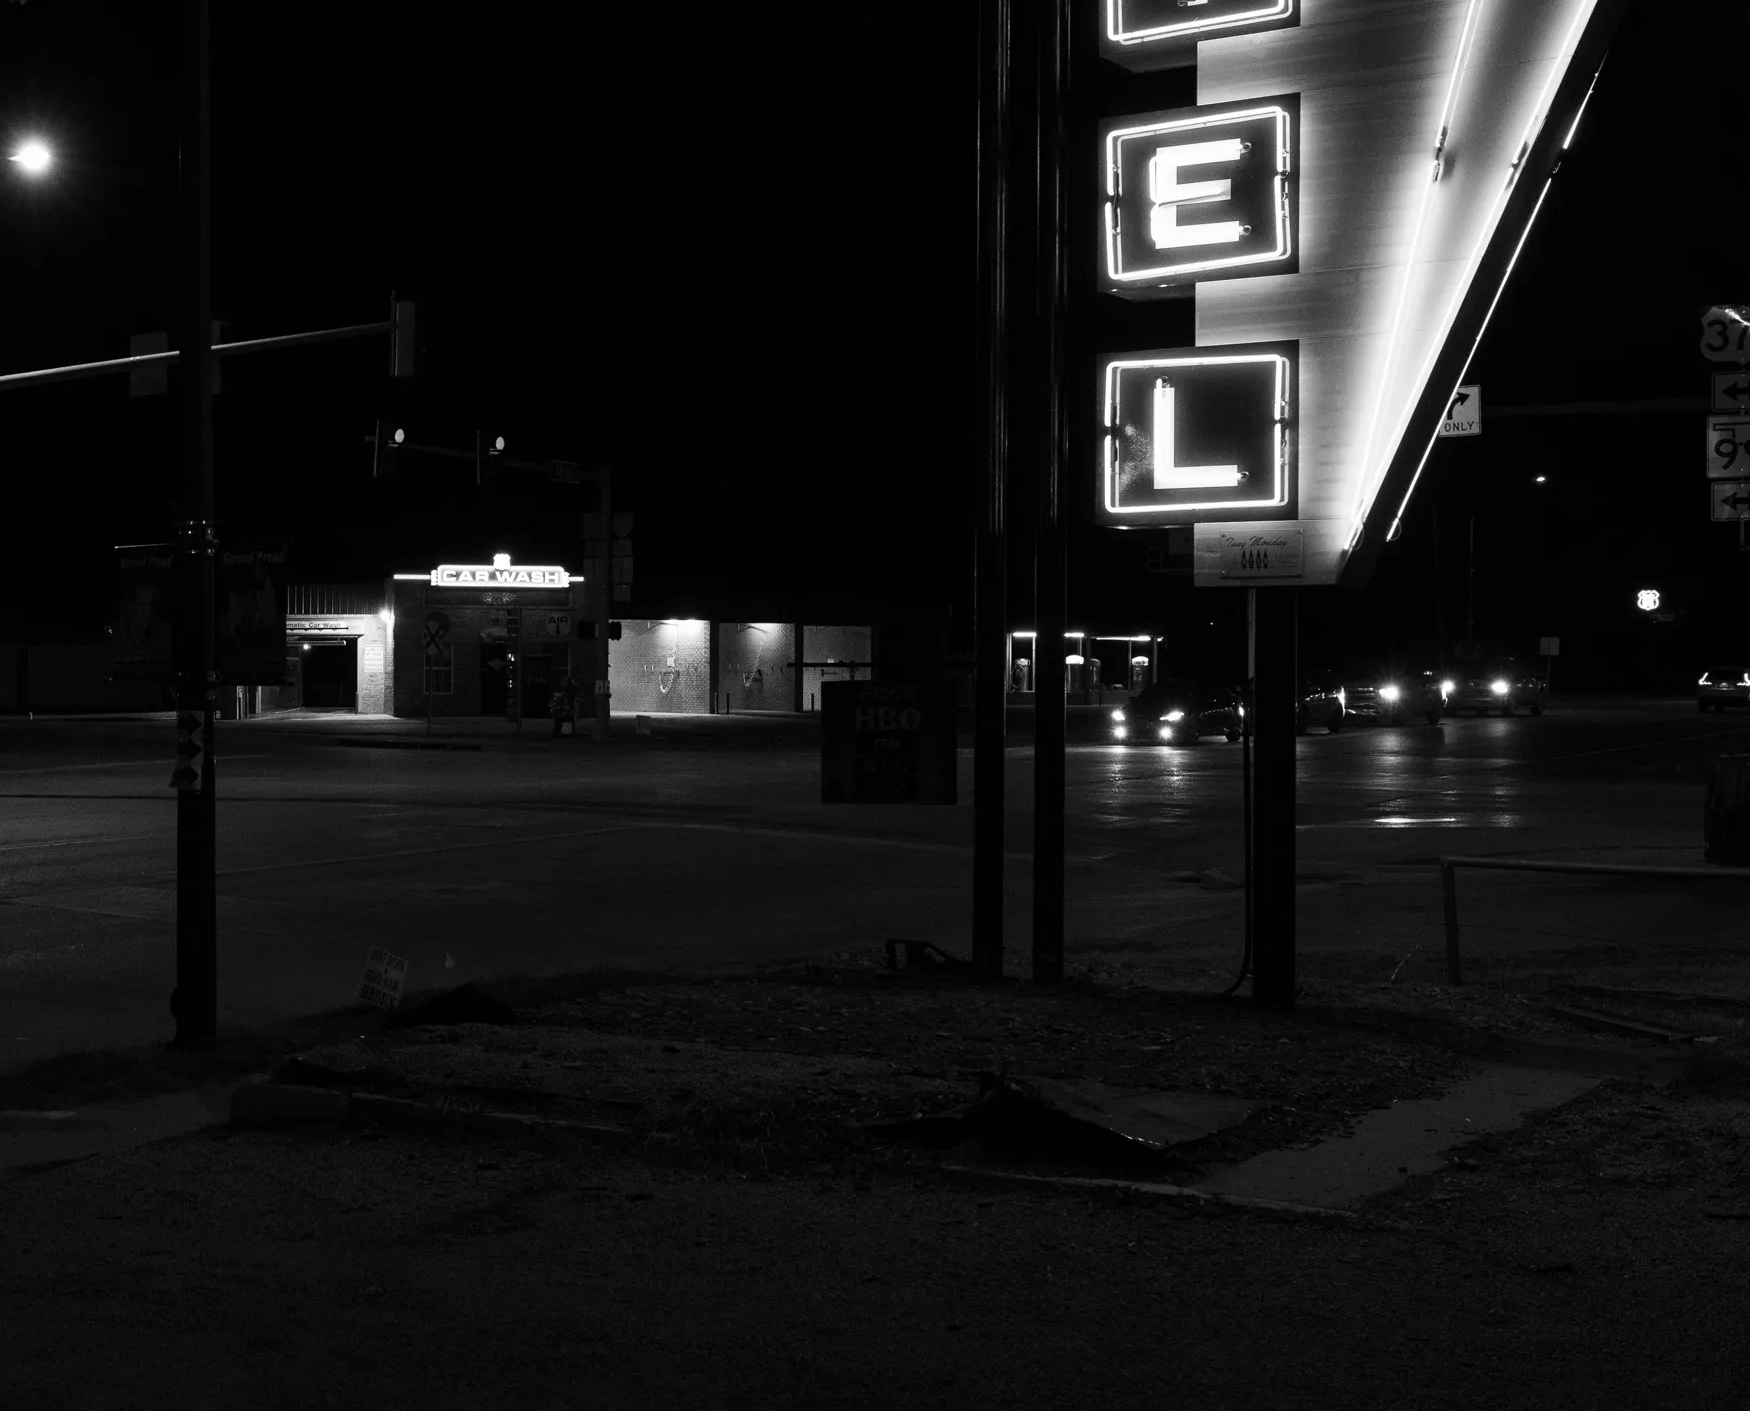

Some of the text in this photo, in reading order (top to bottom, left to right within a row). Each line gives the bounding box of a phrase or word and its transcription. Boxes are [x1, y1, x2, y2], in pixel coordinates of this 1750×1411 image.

[1444, 421, 1475, 432] ONLY
[1714, 438, 1750, 471] 9
[442, 570, 559, 584] CAR WASH
[547, 616, 569, 625] AIR
[855, 706, 921, 731] HBO
